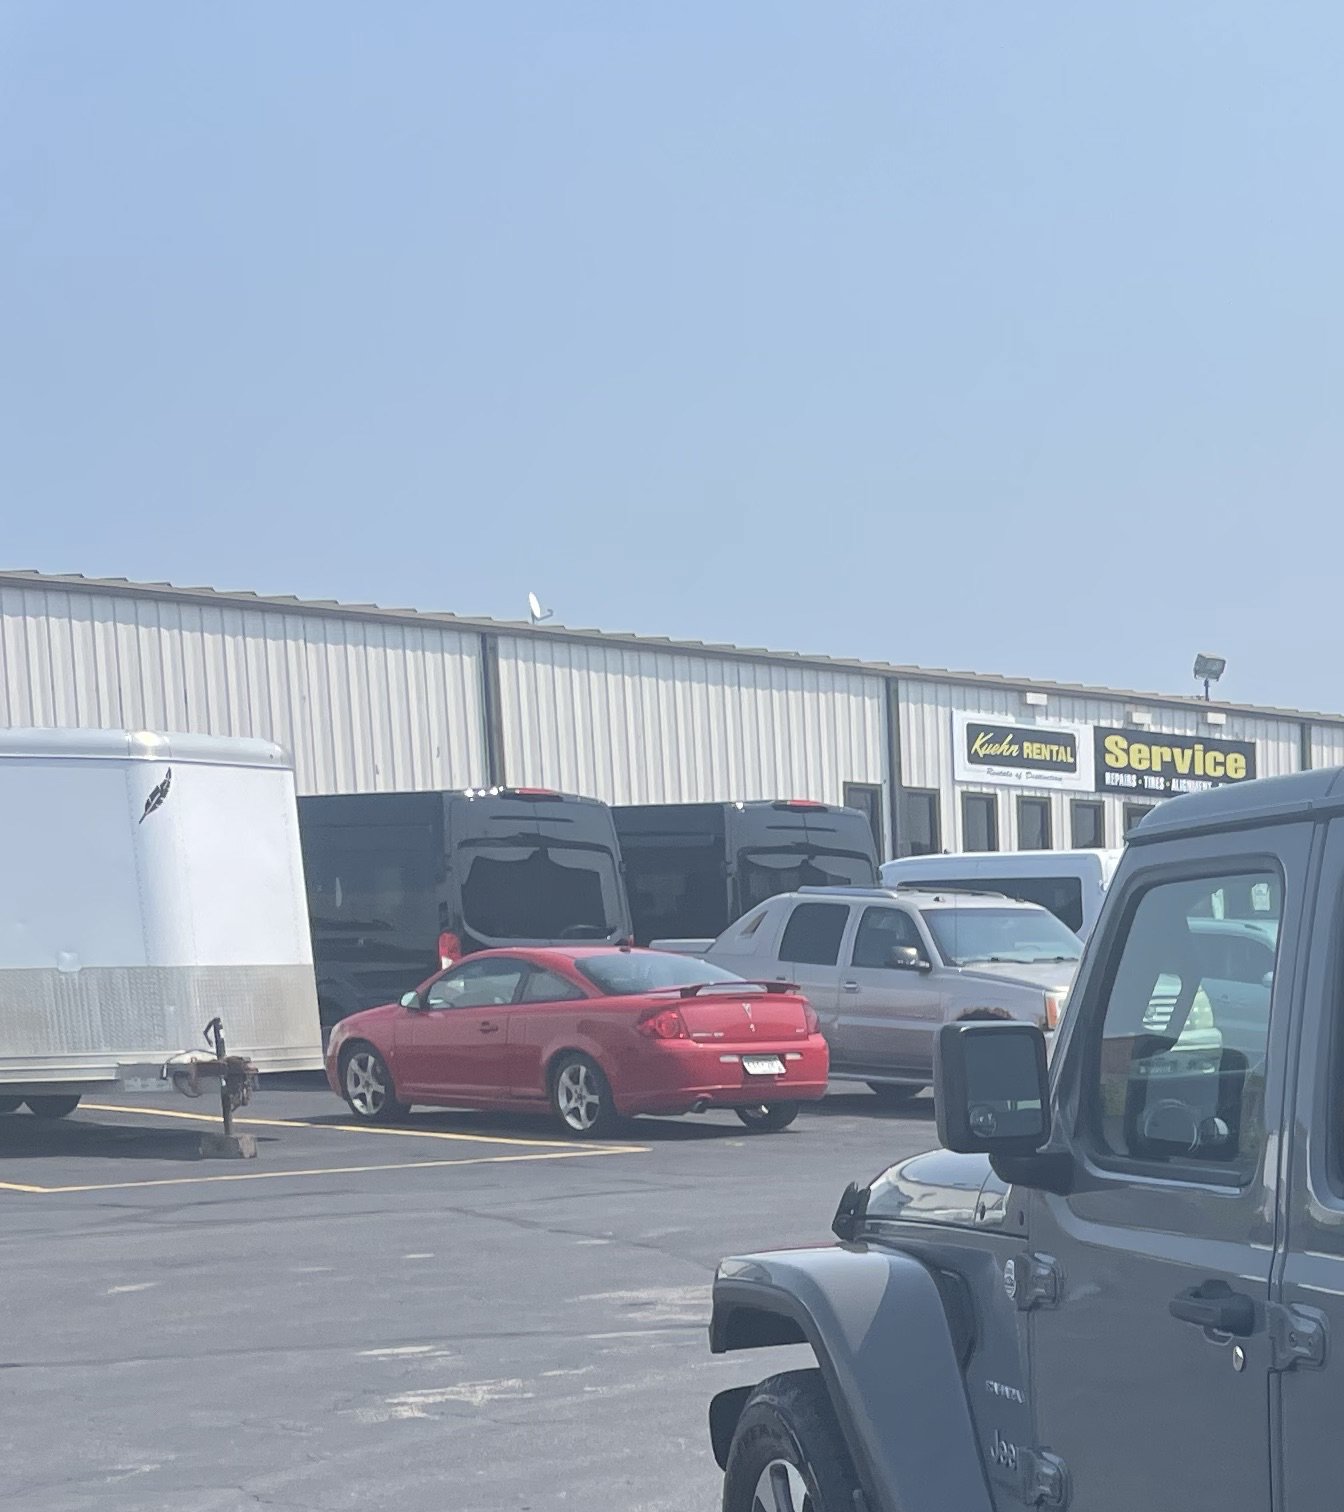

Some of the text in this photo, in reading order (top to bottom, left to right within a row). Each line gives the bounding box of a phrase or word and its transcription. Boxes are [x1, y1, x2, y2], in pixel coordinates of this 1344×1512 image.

[970, 731, 1075, 763] Kuehn RENTAL
[1104, 734, 1246, 779] Service
[1104, 772, 1137, 788] REPAIRS
[1143, 775, 1165, 790] TIRES
